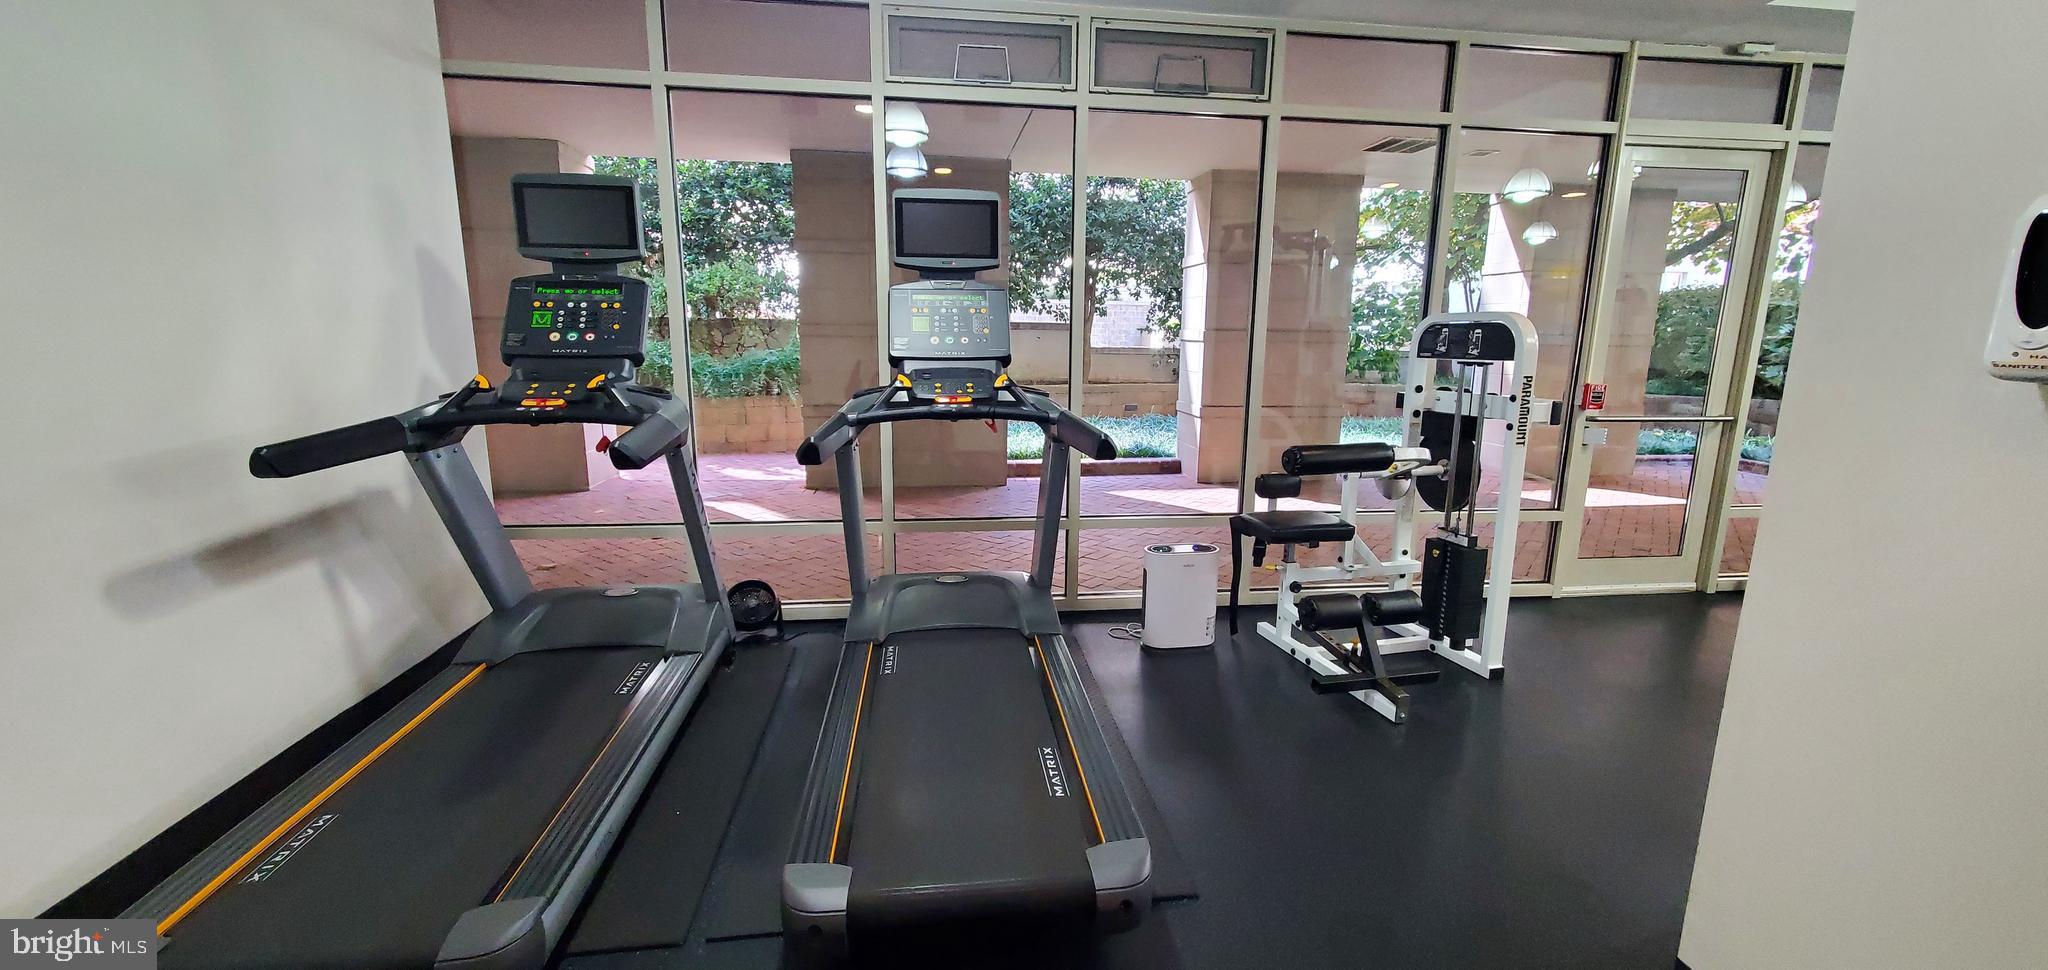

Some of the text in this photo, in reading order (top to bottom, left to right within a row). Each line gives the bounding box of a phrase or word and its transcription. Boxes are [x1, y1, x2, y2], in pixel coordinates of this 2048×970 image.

[1515, 375, 1533, 447] PARAMOUNT
[619, 662, 651, 694] MATRIX
[884, 645, 895, 675] MATRIX
[1042, 747, 1065, 797] MATRIX
[246, 814, 333, 883] MATRIX
